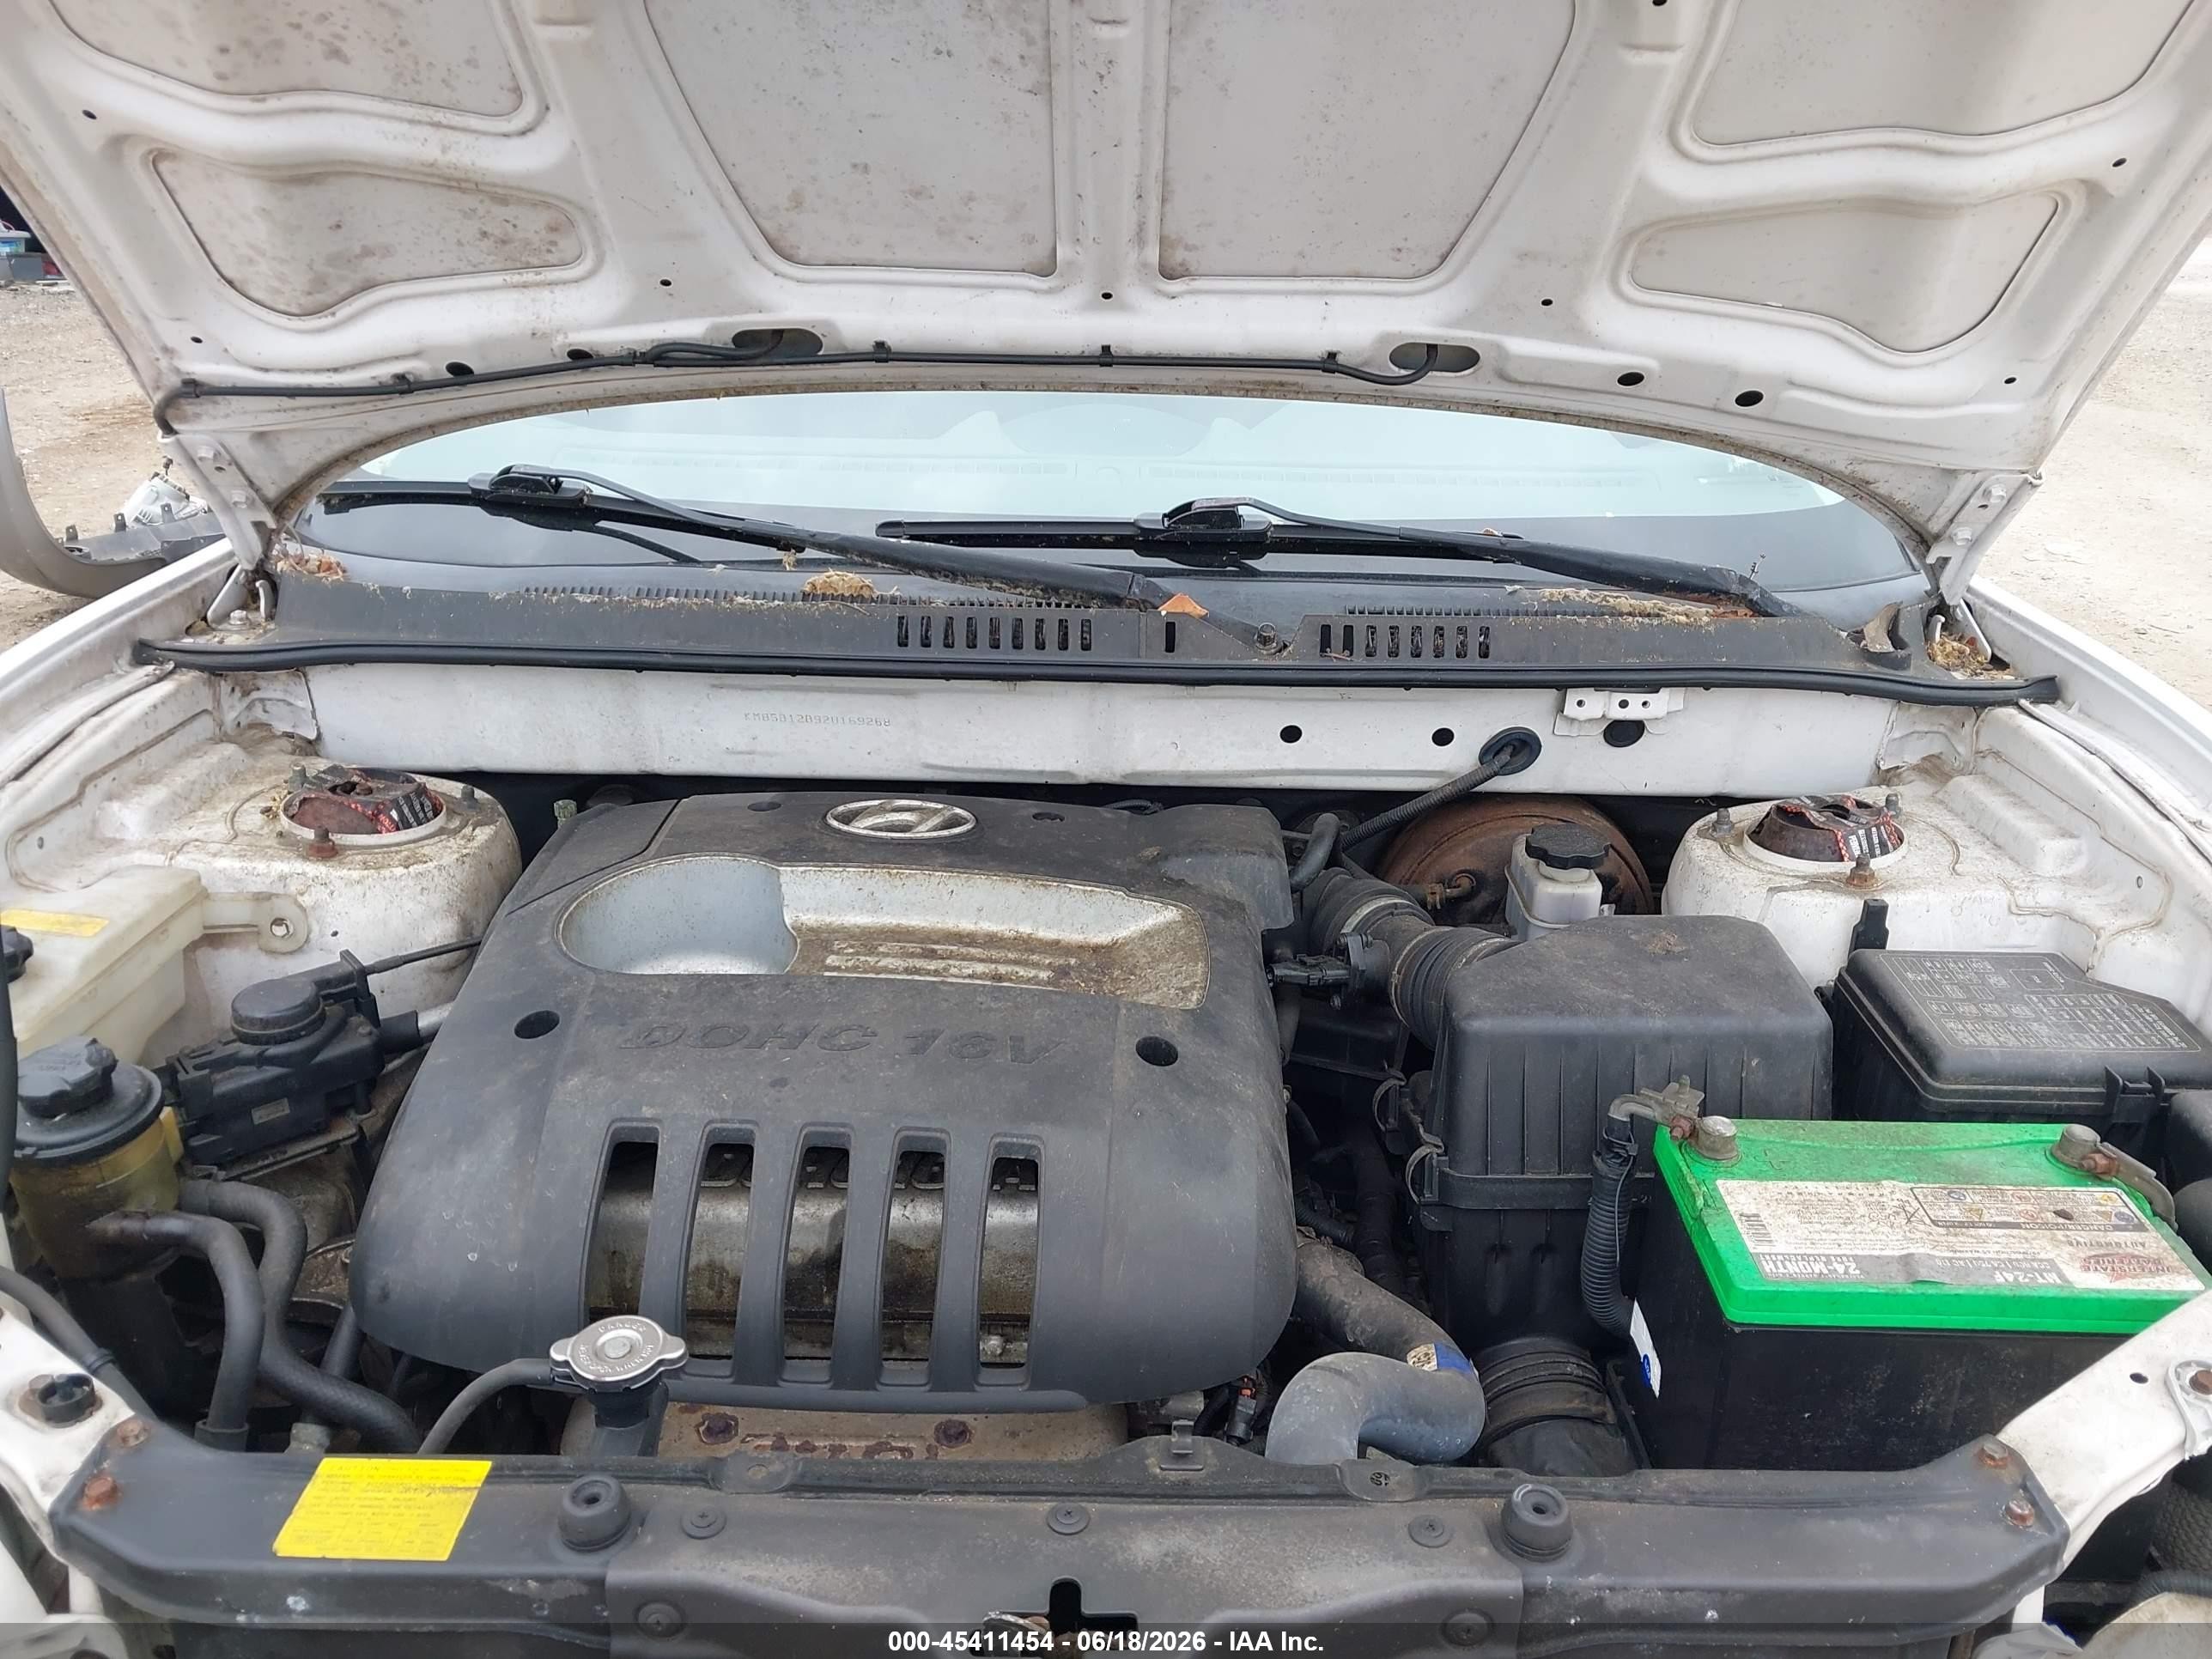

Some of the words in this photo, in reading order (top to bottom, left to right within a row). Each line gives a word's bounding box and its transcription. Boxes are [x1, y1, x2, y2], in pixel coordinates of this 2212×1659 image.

[618, 1023, 878, 1053] DOHC
[905, 1027, 1065, 1066] 16V
[1761, 1261, 1861, 1274] 24-MONTH
[2081, 1265, 2172, 1273] INTERSTATE
